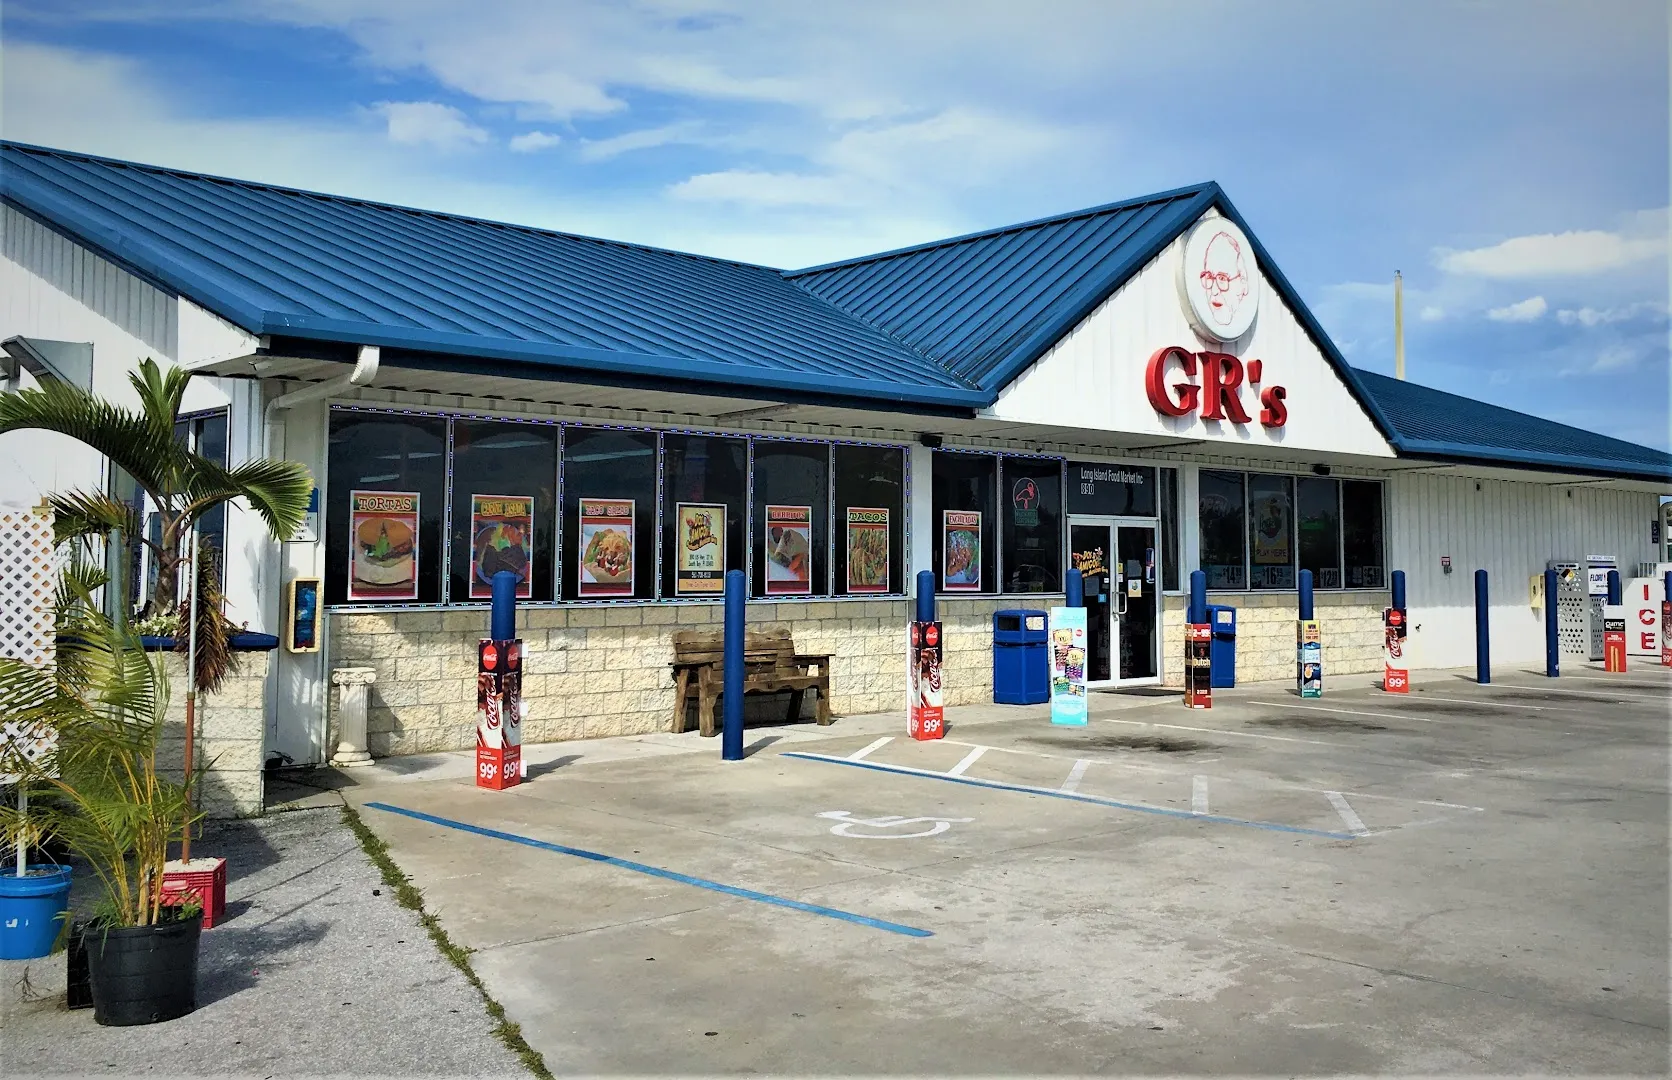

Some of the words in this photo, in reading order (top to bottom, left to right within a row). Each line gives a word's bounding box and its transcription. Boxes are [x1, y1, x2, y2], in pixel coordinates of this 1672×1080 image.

[1146, 346, 1287, 428] GR's
[1081, 467, 1093, 483] Long
[1094, 468, 1107, 481] Island
[1108, 469, 1120, 482] Food
[1121, 471, 1135, 484] Market
[1081, 483, 1094, 495] 890
[358, 496, 412, 511] TORTAS
[481, 502, 503, 516] CARNE
[505, 502, 526, 517] ASADA
[849, 512, 887, 522] TACOS
[1273, 549, 1287, 557] HERE
[1639, 584, 1656, 650] ICE
[1605, 621, 1624, 631] game
[1193, 658, 1211, 667] Dutch
[1389, 677, 1405, 687] 99¢
[923, 719, 940, 732] 99¢
[480, 762, 498, 780] 99¢
[504, 760, 520, 779] 99¢
